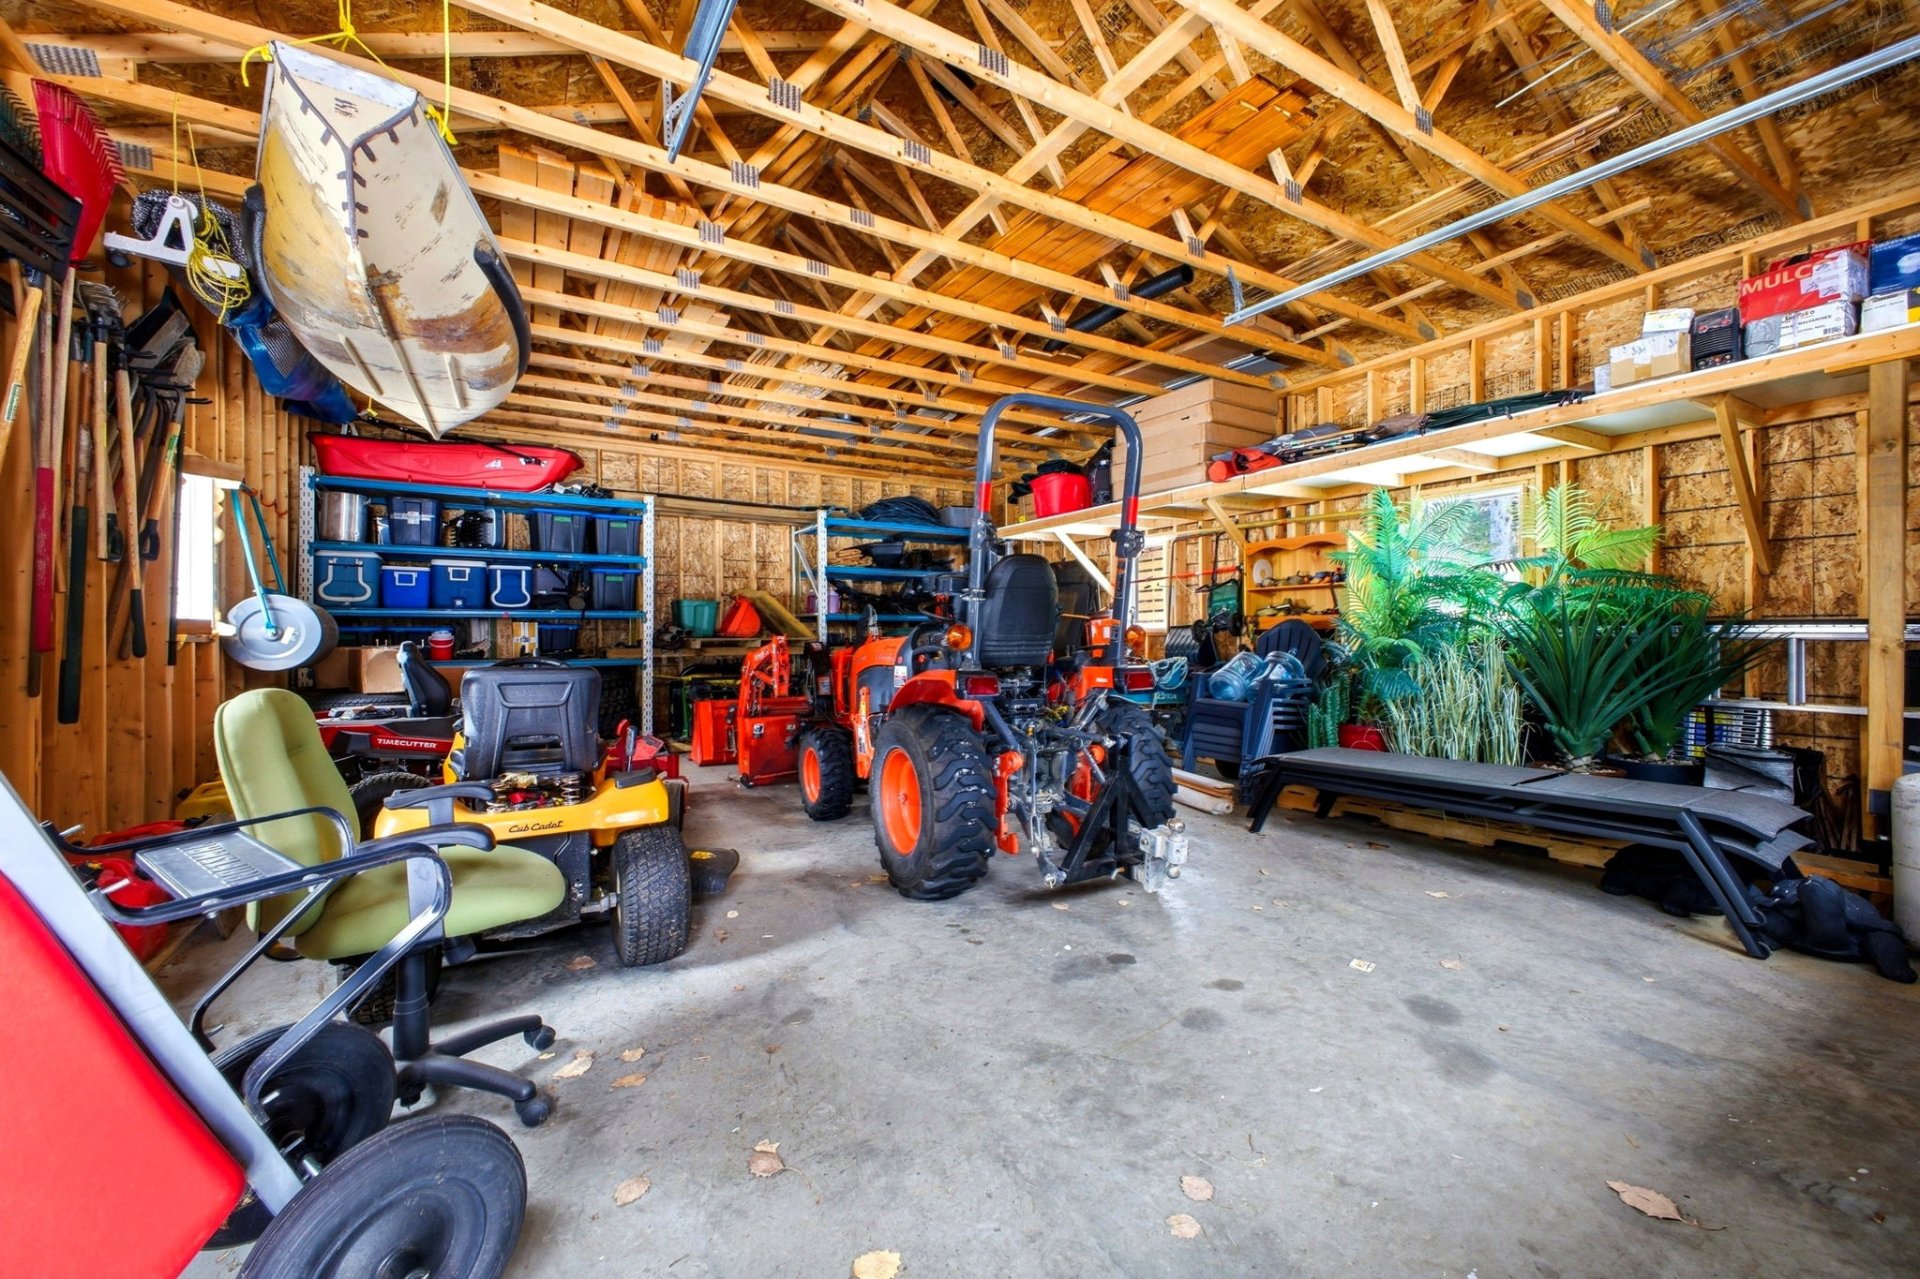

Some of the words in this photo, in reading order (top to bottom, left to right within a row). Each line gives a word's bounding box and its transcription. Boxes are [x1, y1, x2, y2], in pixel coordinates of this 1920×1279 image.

[1741, 261, 1820, 297] MULC
[377, 738, 437, 748] TIMECUTTER
[509, 825, 529, 833] Cub
[531, 821, 563, 831] Cadet
